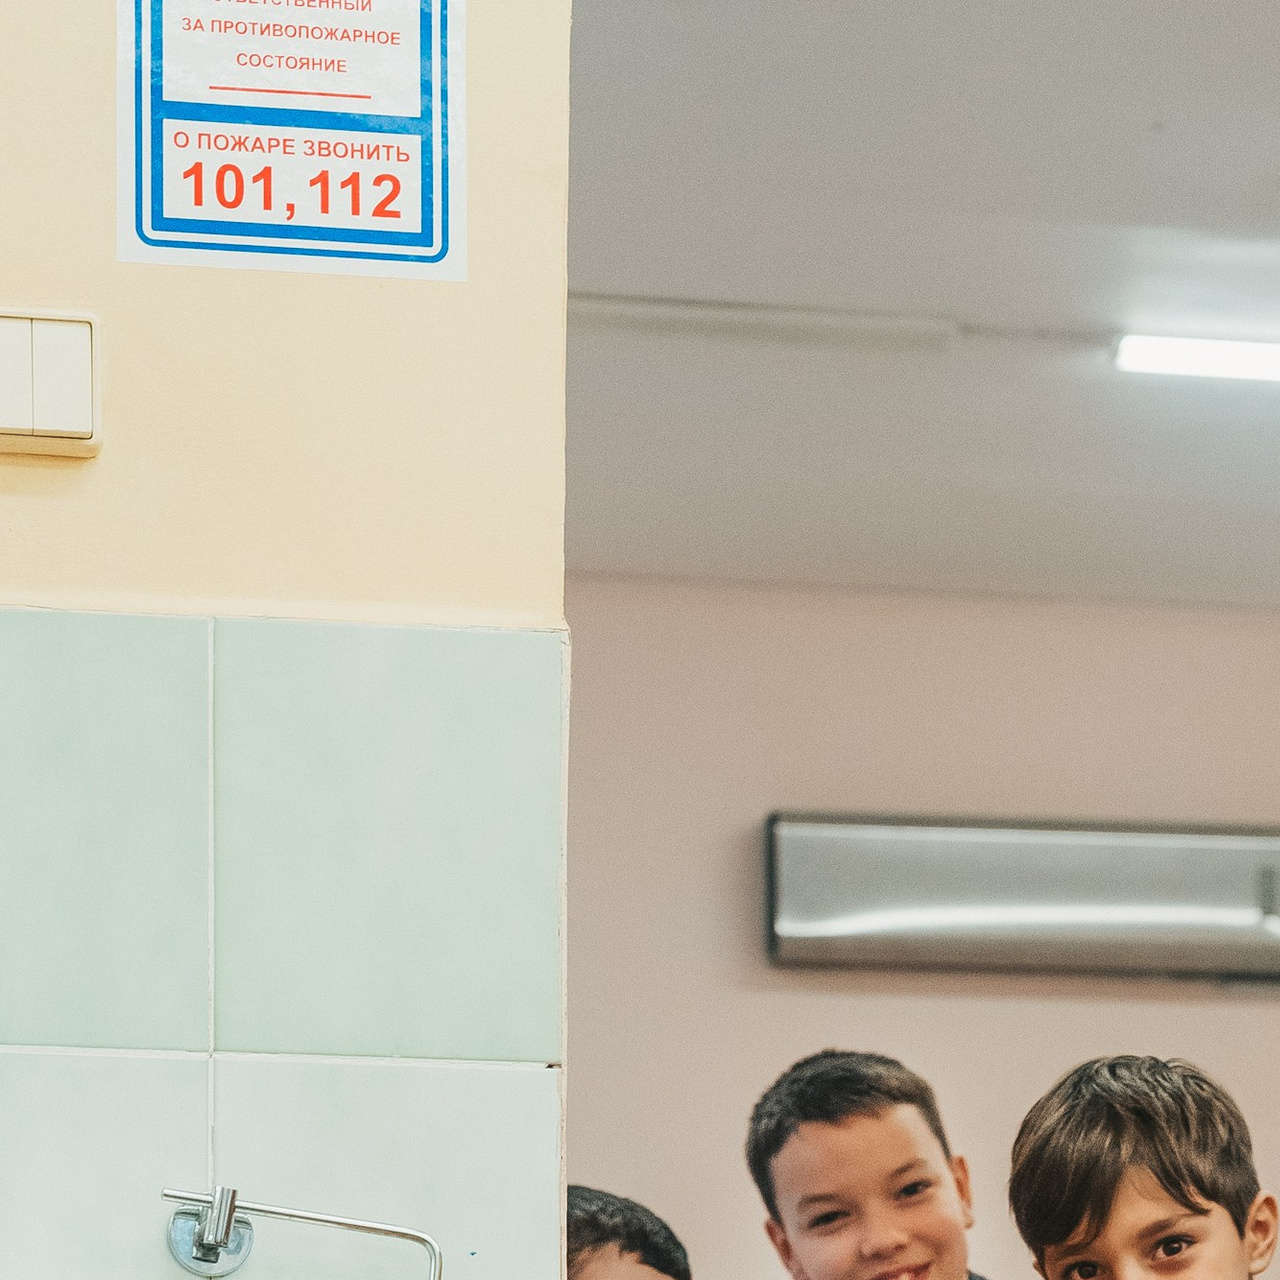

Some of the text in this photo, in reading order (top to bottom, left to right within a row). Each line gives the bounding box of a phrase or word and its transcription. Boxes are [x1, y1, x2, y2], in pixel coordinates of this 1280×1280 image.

[182, 16, 401, 46] ЗА ПРОТИВОПОЖАРНОЕ
[235, 52, 348, 73] СОСТОЯНИЕ
[172, 130, 411, 163] О ПОЖАРЕ ЗВОНИТЬ
